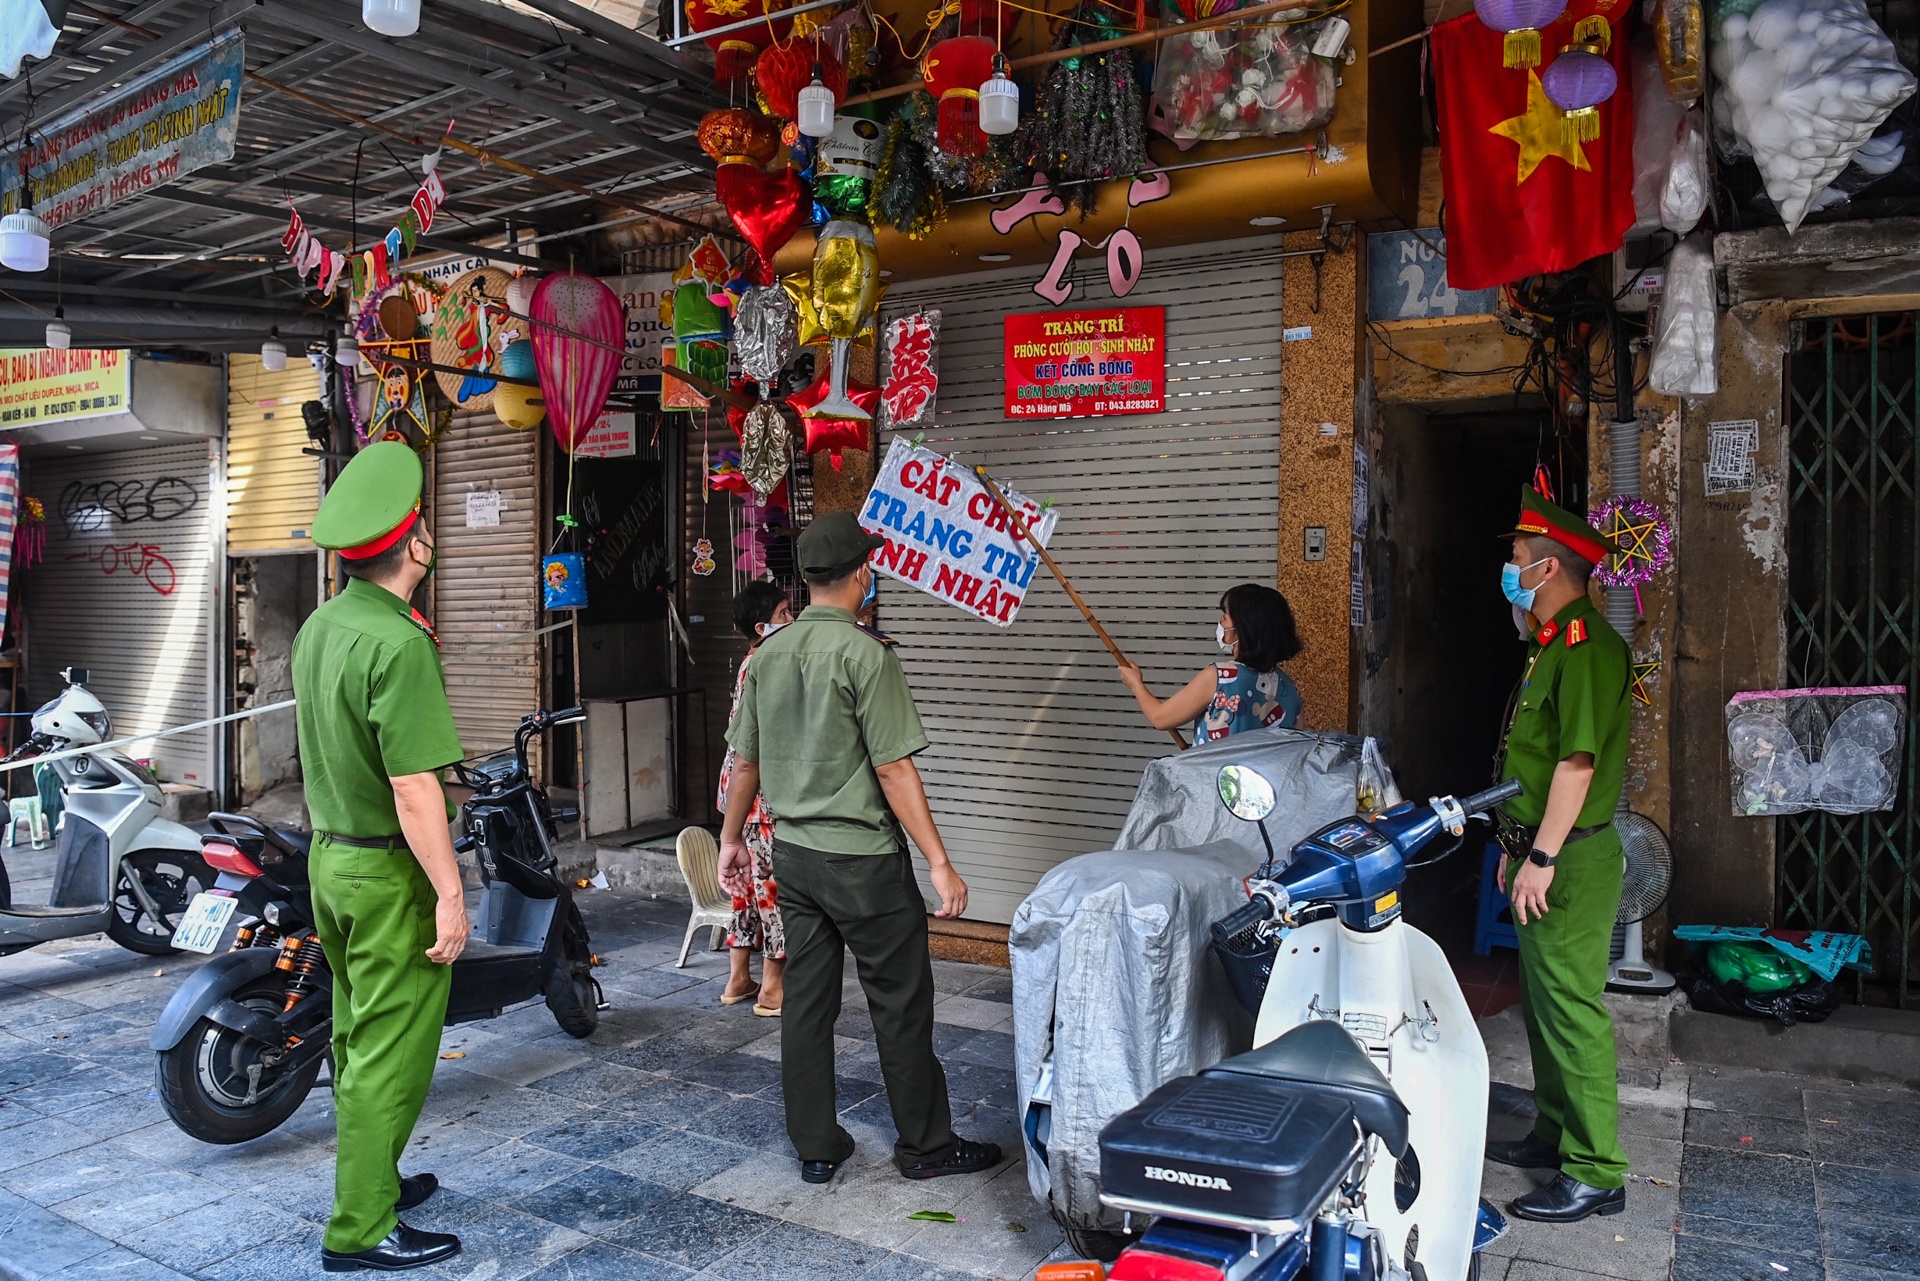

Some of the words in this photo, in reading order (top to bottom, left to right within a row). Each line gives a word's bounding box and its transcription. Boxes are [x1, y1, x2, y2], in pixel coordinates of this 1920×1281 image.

[106, 129, 140, 170] TRANG
[143, 109, 164, 152] TRÍ
[163, 104, 194, 145] SINH
[196, 86, 229, 131] NHẬT
[109, 164, 152, 202] HÀNG
[157, 149, 181, 181] MÃ
[351, 160, 447, 301] BIRTHDA
[423, 261, 461, 280] NHẬN
[1397, 264, 1459, 317] 24
[1043, 319, 1095, 336] TRANG
[1098, 314, 1124, 333] TRÍ
[1013, 340, 1047, 359] PHÔNG
[1049, 338, 1074, 356] CƯỚI
[1076, 336, 1094, 355] HỎI
[1100, 338, 1125, 354] SINH
[1127, 334, 1155, 355] NHẬT
[12, 353, 27, 385] BAO
[1035, 358, 1058, 379] KẾT
[1061, 358, 1095, 377] CỔNG
[15, 388, 28, 403] CHẤT
[29, 389, 41, 403] LIỆU
[41, 387, 65, 399] DUPLEX,
[84, 381, 99, 391] MICA
[617, 376, 638, 389] MÃ
[1017, 384, 1042, 399] BƠM
[1079, 383, 1100, 396] BAY
[1103, 379, 1125, 395] CÁC
[1127, 379, 1153, 398] LOẠI
[1011, 405, 1025, 414] ĐC:
[1026, 404, 1036, 414] 24
[1037, 403, 1057, 414] Hàng
[1058, 403, 1072, 413] Mã
[1094, 401, 1108, 411] ĐT:
[1109, 399, 1160, 411] 043.8283821
[899, 457, 961, 506] CẮT
[967, 491, 1042, 541] CHỮ
[866, 489, 974, 559] TRANG
[982, 542, 1041, 589] TRÍ
[932, 563, 1021, 622] NHẬT
[176, 923, 221, 948] 341.07
[1144, 1166, 1232, 1191] HONDA
